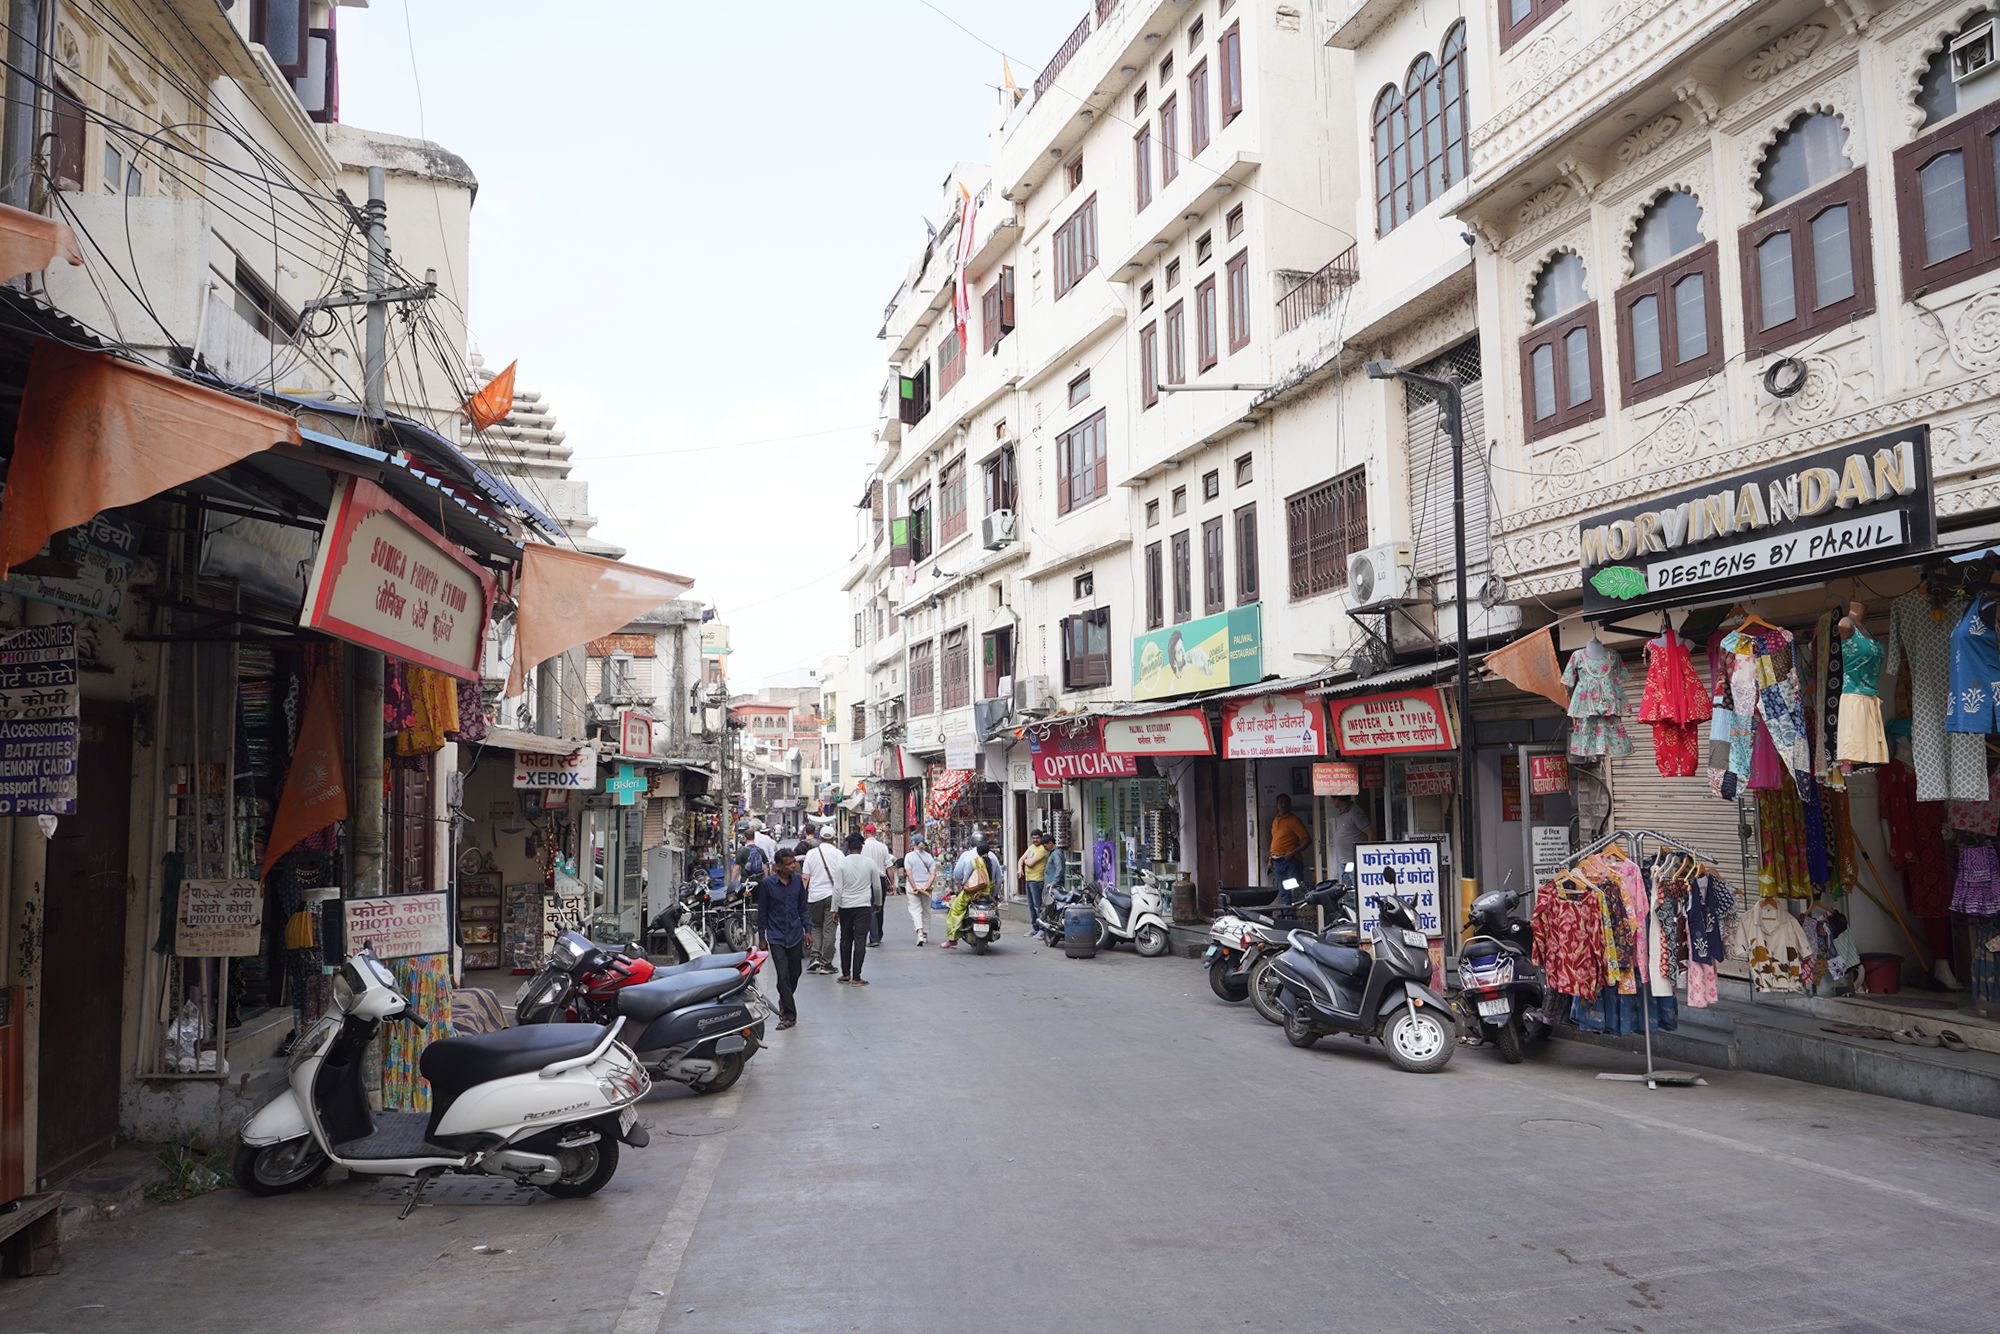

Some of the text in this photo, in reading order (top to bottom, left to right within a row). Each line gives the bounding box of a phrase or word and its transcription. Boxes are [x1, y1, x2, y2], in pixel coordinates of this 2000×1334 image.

[1580, 441, 1917, 569] MORVINANDAN
[1658, 524, 1895, 589] DESIGNS BY PARUL
[56, 587, 77, 603] Passport
[410, 561, 440, 597] PHOTO
[441, 579, 468, 613] STUDIO
[2, 624, 72, 650] ACCESSORIES
[0, 647, 72, 664] PHOTO COPY
[1229, 646, 1258, 660] RESTAURANT
[26, 663, 74, 687] फोटो
[22, 705, 70, 718] COPY
[1363, 700, 1405, 715] MAHAVEER
[1146, 723, 1171, 733] RESTAURANT
[1236, 717, 1246, 733] श्री
[1247, 716, 1256, 732] माँ
[1257, 713, 1278, 731] लक्ष्मी
[1347, 717, 1382, 731] INFOTECH
[1388, 715, 1394, 727] &
[1400, 711, 1433, 725] TYPING
[0, 720, 75, 740] Accessories
[4, 741, 72, 759] BATTERIES
[42, 759, 72, 774] CARD
[1044, 752, 1125, 776] OPTICIAN
[1534, 759, 1542, 777] 1
[39, 777, 69, 793] Photo
[526, 771, 580, 786] XEROX
[613, 779, 640, 790] Bisleri
[16, 799, 68, 812] PRINT
[1362, 848, 1432, 866] फोटोकोपी
[1407, 866, 1435, 884] फोटो
[230, 884, 256, 899] फोटो
[1421, 889, 1433, 906] से
[192, 900, 253, 914] फोटो कोपी
[352, 898, 442, 918] फोटो कोपी
[189, 914, 256, 924] PHOTO COPY
[350, 913, 445, 931] PHOTO COPY
[386, 941, 421, 955] PHOTO
